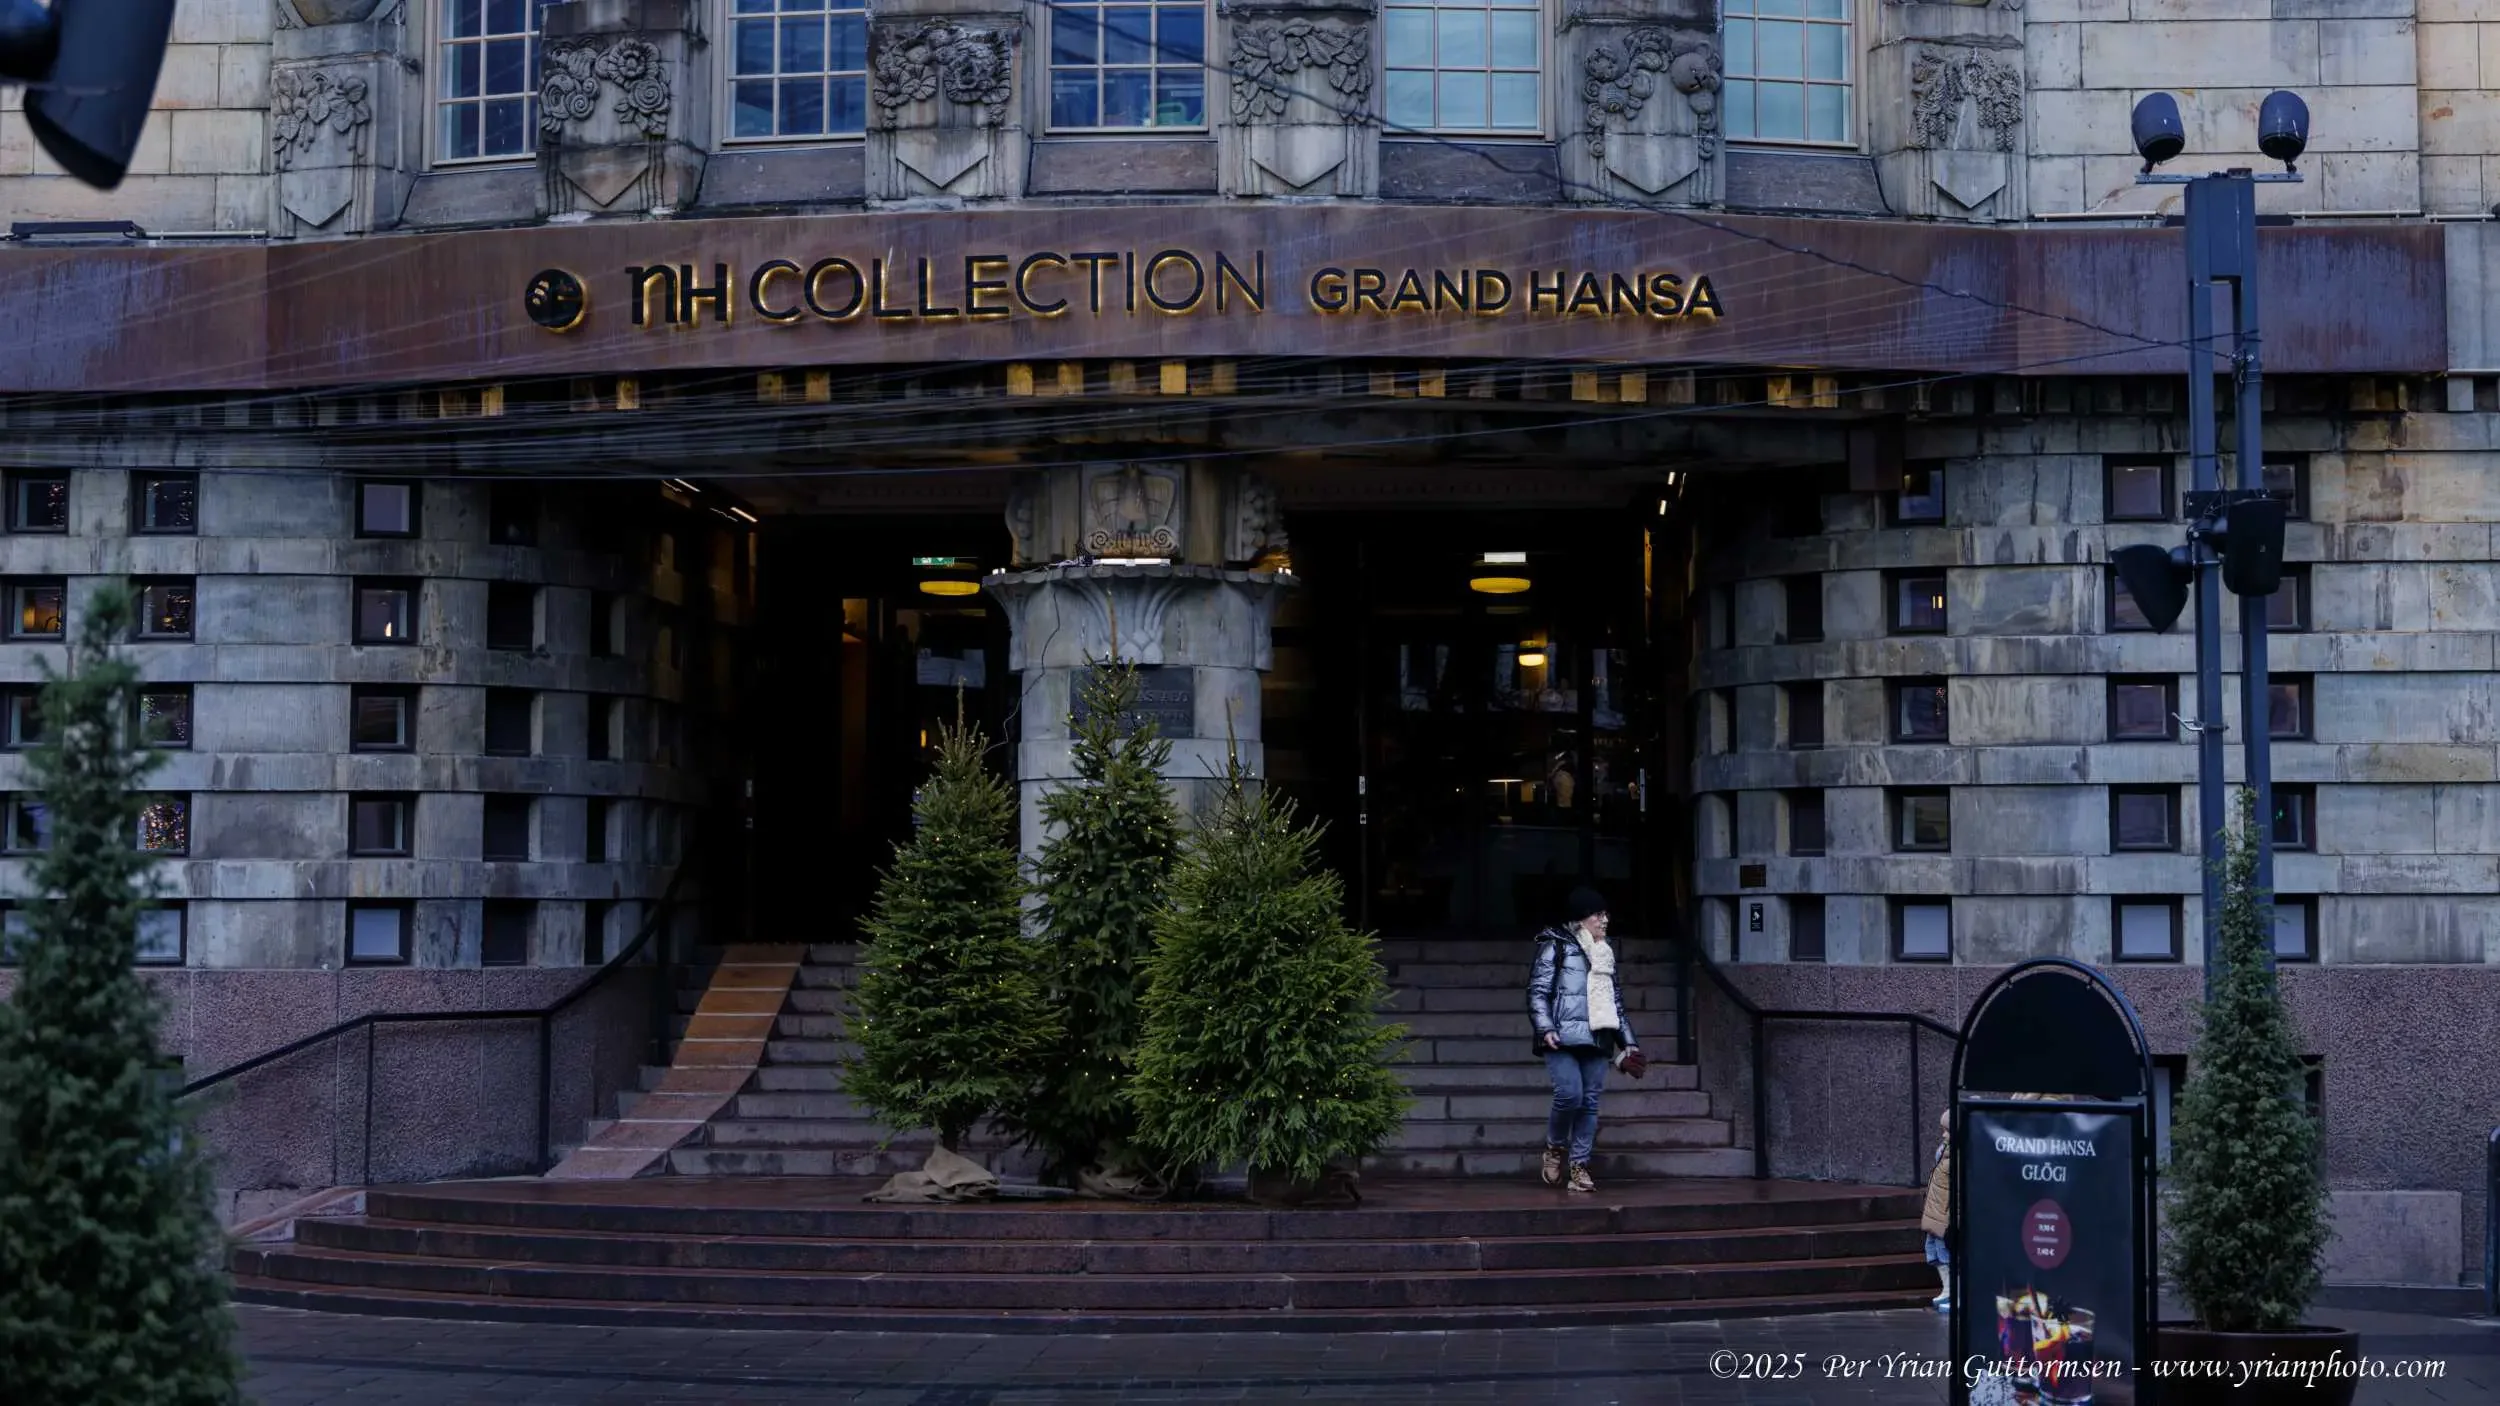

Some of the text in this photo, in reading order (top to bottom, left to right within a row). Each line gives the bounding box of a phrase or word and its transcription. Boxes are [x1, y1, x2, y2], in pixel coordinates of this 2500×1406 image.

[748, 249, 1266, 322] COLLECTION
[1309, 268, 1512, 315] GRAND
[1529, 271, 1724, 320] HANSA
[1995, 1136, 2096, 1157] GRAND HANSA
